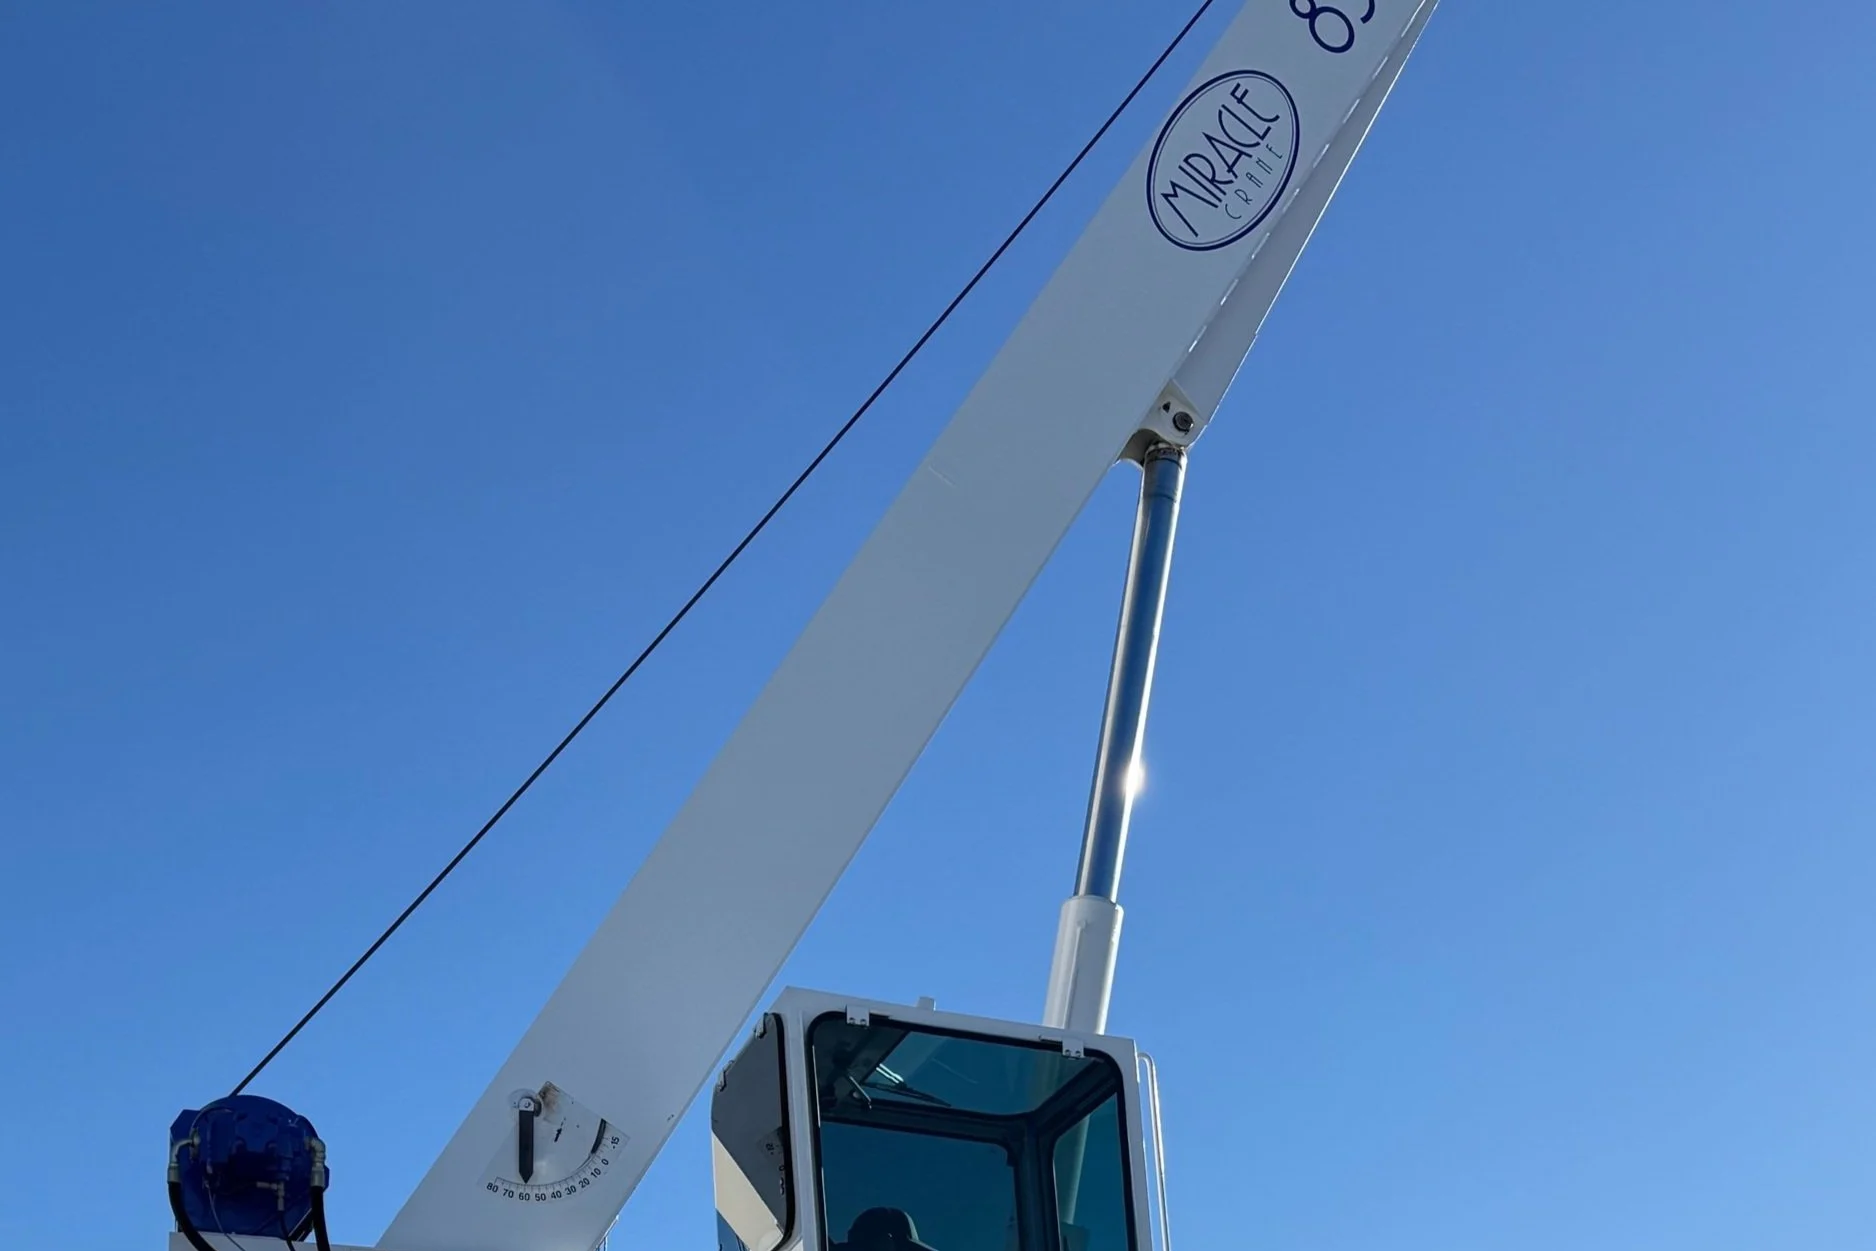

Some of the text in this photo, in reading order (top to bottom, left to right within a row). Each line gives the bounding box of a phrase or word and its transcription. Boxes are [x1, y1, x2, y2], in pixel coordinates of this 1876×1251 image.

[1160, 82, 1280, 238] MIRACLE
[1224, 143, 1283, 220] CRANE
[486, 1136, 620, 1201] 80 70 60 50 40 30 20 10 0 -15
